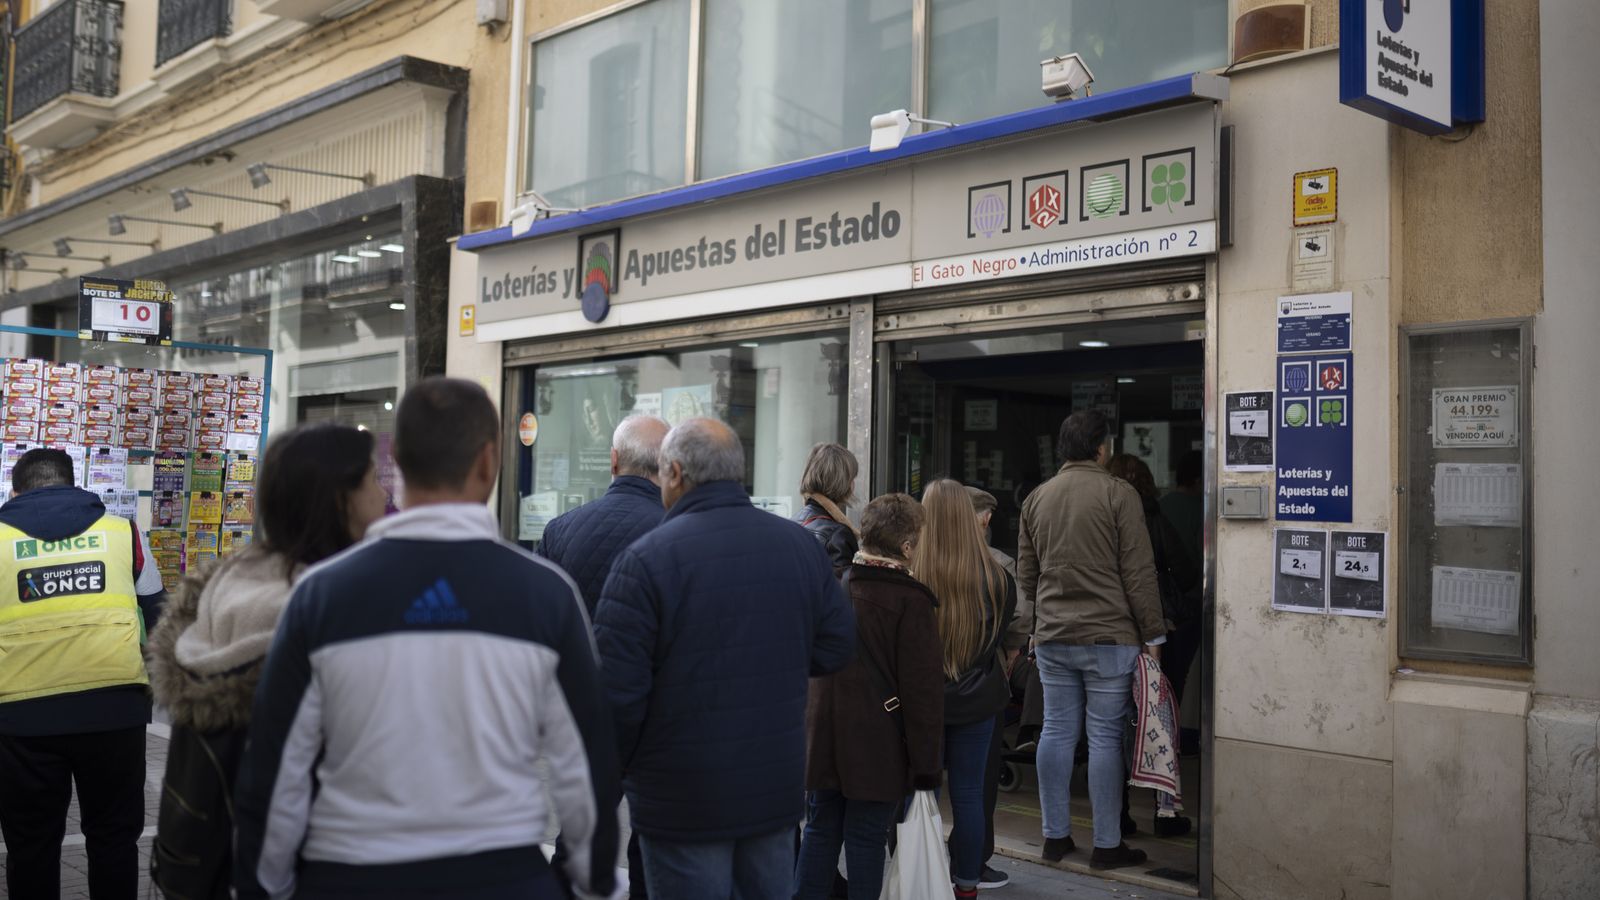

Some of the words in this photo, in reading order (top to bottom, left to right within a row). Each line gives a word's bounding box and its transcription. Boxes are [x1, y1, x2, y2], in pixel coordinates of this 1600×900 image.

[1377, 30, 1412, 60] Loterías
[1413, 50, 1420, 67] y
[1378, 51, 1418, 82] Apuestas
[1419, 69, 1433, 88] del
[1378, 71, 1409, 97] Estado
[481, 266, 557, 303] Loterías
[562, 267, 575, 299] y
[624, 235, 737, 286] Apuestas
[745, 219, 786, 261] del
[795, 201, 901, 252] Estado
[913, 265, 924, 282] El
[931, 262, 965, 280] Gato
[972, 256, 1017, 277] Negro
[1028, 237, 1149, 268] Administración
[1187, 230, 1198, 248] 2
[83, 289, 108, 297] BOTE
[109, 291, 121, 299] DE
[1240, 396, 1257, 407] BOTE
[1443, 395, 1469, 404] GRAN
[1472, 393, 1506, 402] PREMIO
[1450, 405, 1493, 416] 44.199
[1241, 420, 1255, 430] 17
[1445, 432, 1480, 440] VENDIDO
[1482, 430, 1505, 440] AQUÍ
[1278, 467, 1323, 479] Loterías
[1325, 470, 1332, 481] y
[1278, 485, 1329, 498] Apuestas
[1331, 484, 1349, 497] del
[1278, 502, 1316, 514] Estado
[41, 535, 100, 553] ONCE
[1291, 535, 1309, 546] BOTE
[1347, 536, 1367, 548] BOTE
[1292, 558, 1307, 570] 2,1
[1344, 560, 1369, 573] 24,5
[43, 570, 72, 581] grupo
[74, 564, 101, 574] social
[43, 576, 101, 595] ONCE
